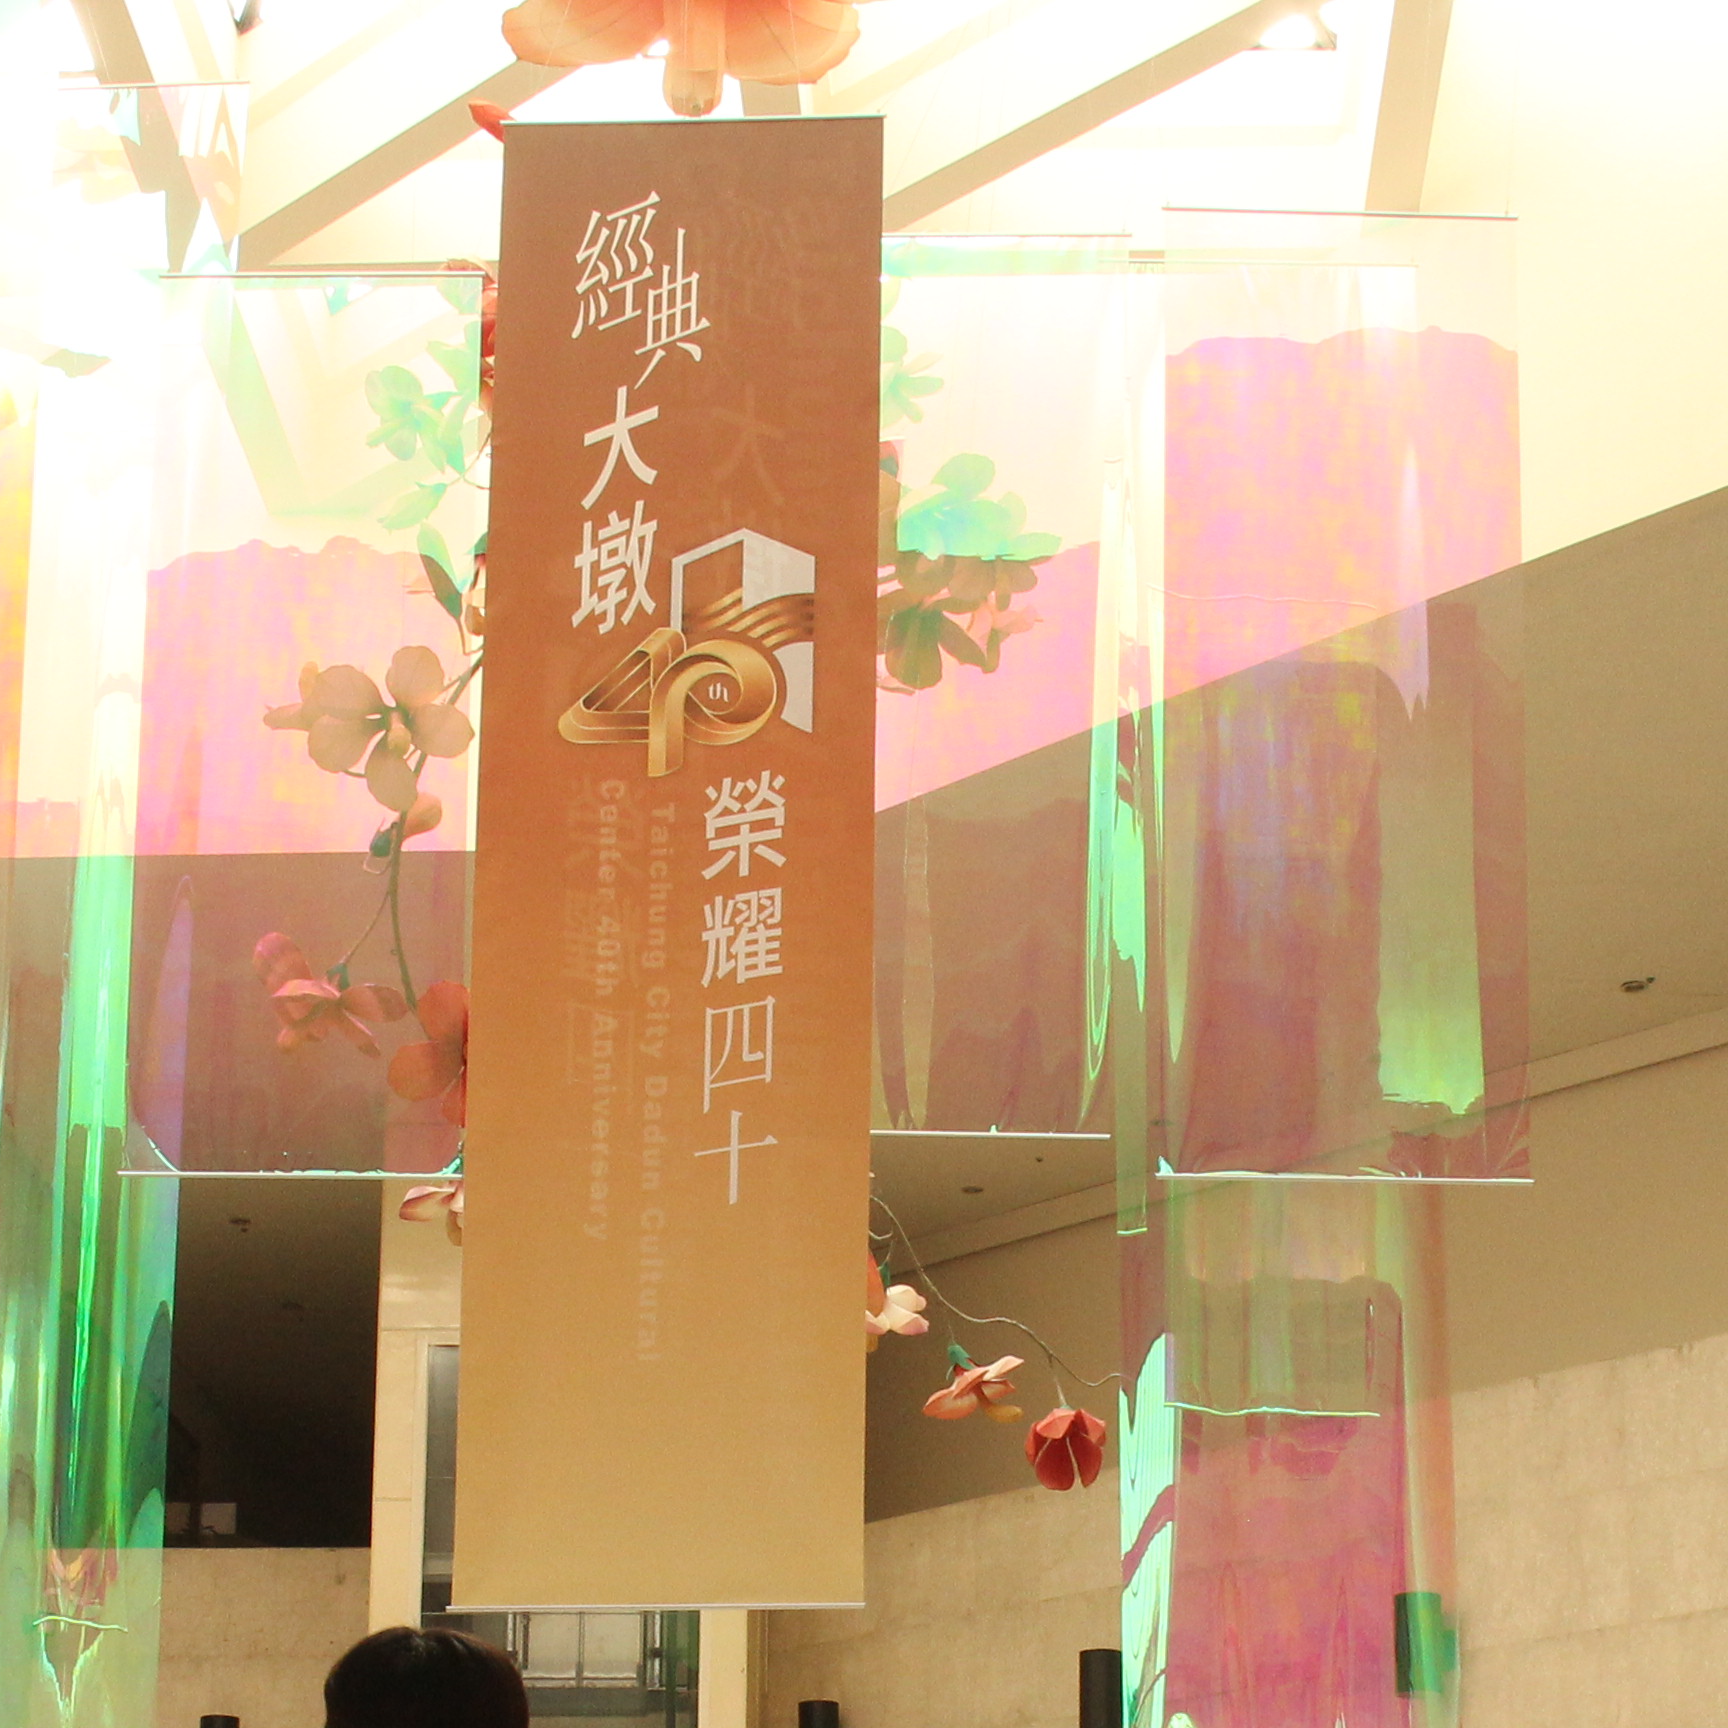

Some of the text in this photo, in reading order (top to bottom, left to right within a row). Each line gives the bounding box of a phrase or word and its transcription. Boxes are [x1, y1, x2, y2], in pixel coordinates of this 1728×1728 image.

[583, 778, 626, 1243] Center 40th Anniversary
[636, 802, 677, 1363] Taichung City Dadun Cultural
[693, 769, 788, 1206] 榮耀四十
